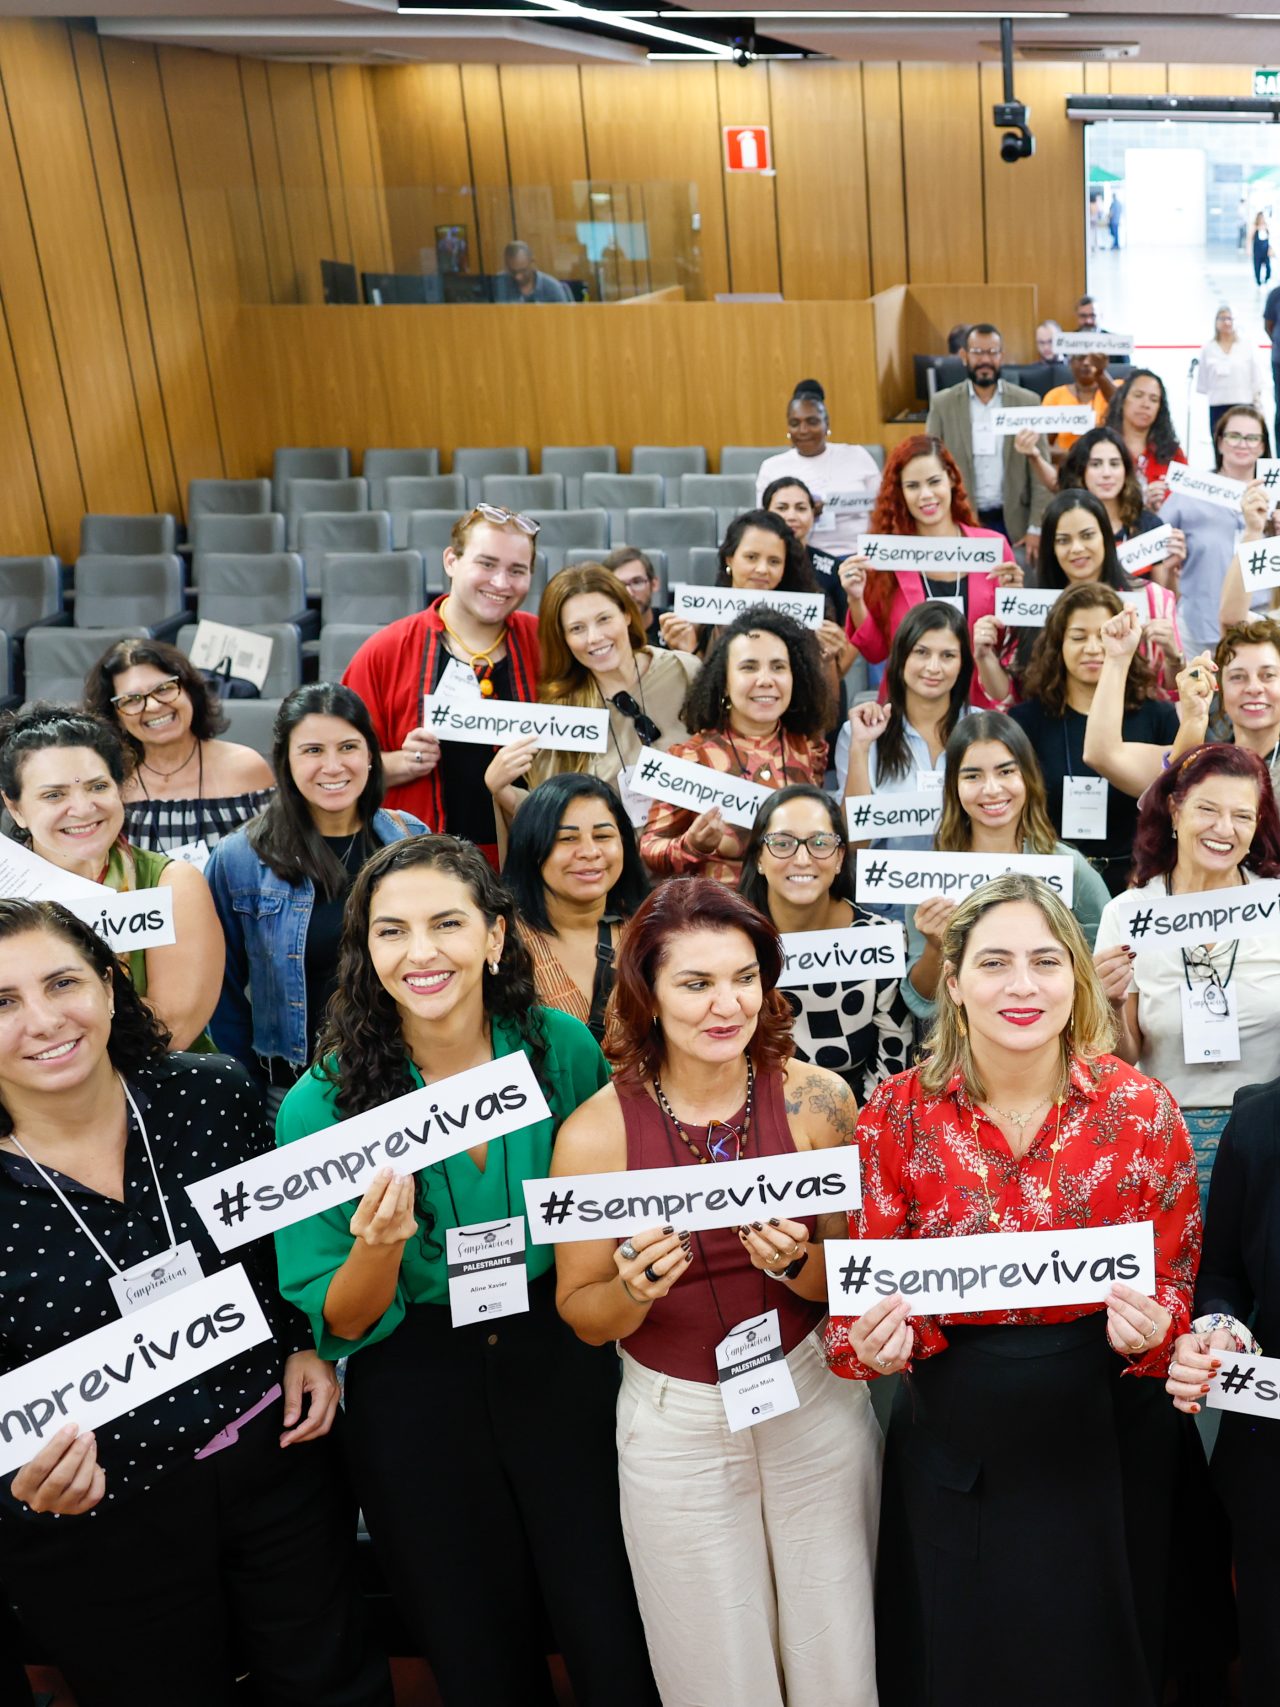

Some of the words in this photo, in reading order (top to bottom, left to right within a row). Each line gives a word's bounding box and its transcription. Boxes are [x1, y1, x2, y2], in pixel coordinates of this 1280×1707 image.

[994, 414, 1089, 429] #semprevivas
[1172, 470, 1241, 500] #semprev
[863, 541, 997, 564] #semprevivas
[431, 704, 600, 741] #semprevivas
[213, 1083, 528, 1228] #semprevivas
[540, 1172, 847, 1226] #semprevivas
[463, 1256, 512, 1273] PALESTRANTE
[839, 1249, 1141, 1300] #semprevivas
[470, 1285, 487, 1293] Aline
[488, 1281, 508, 1290] Xavier
[730, 1353, 772, 1375] PALESTRANTE
